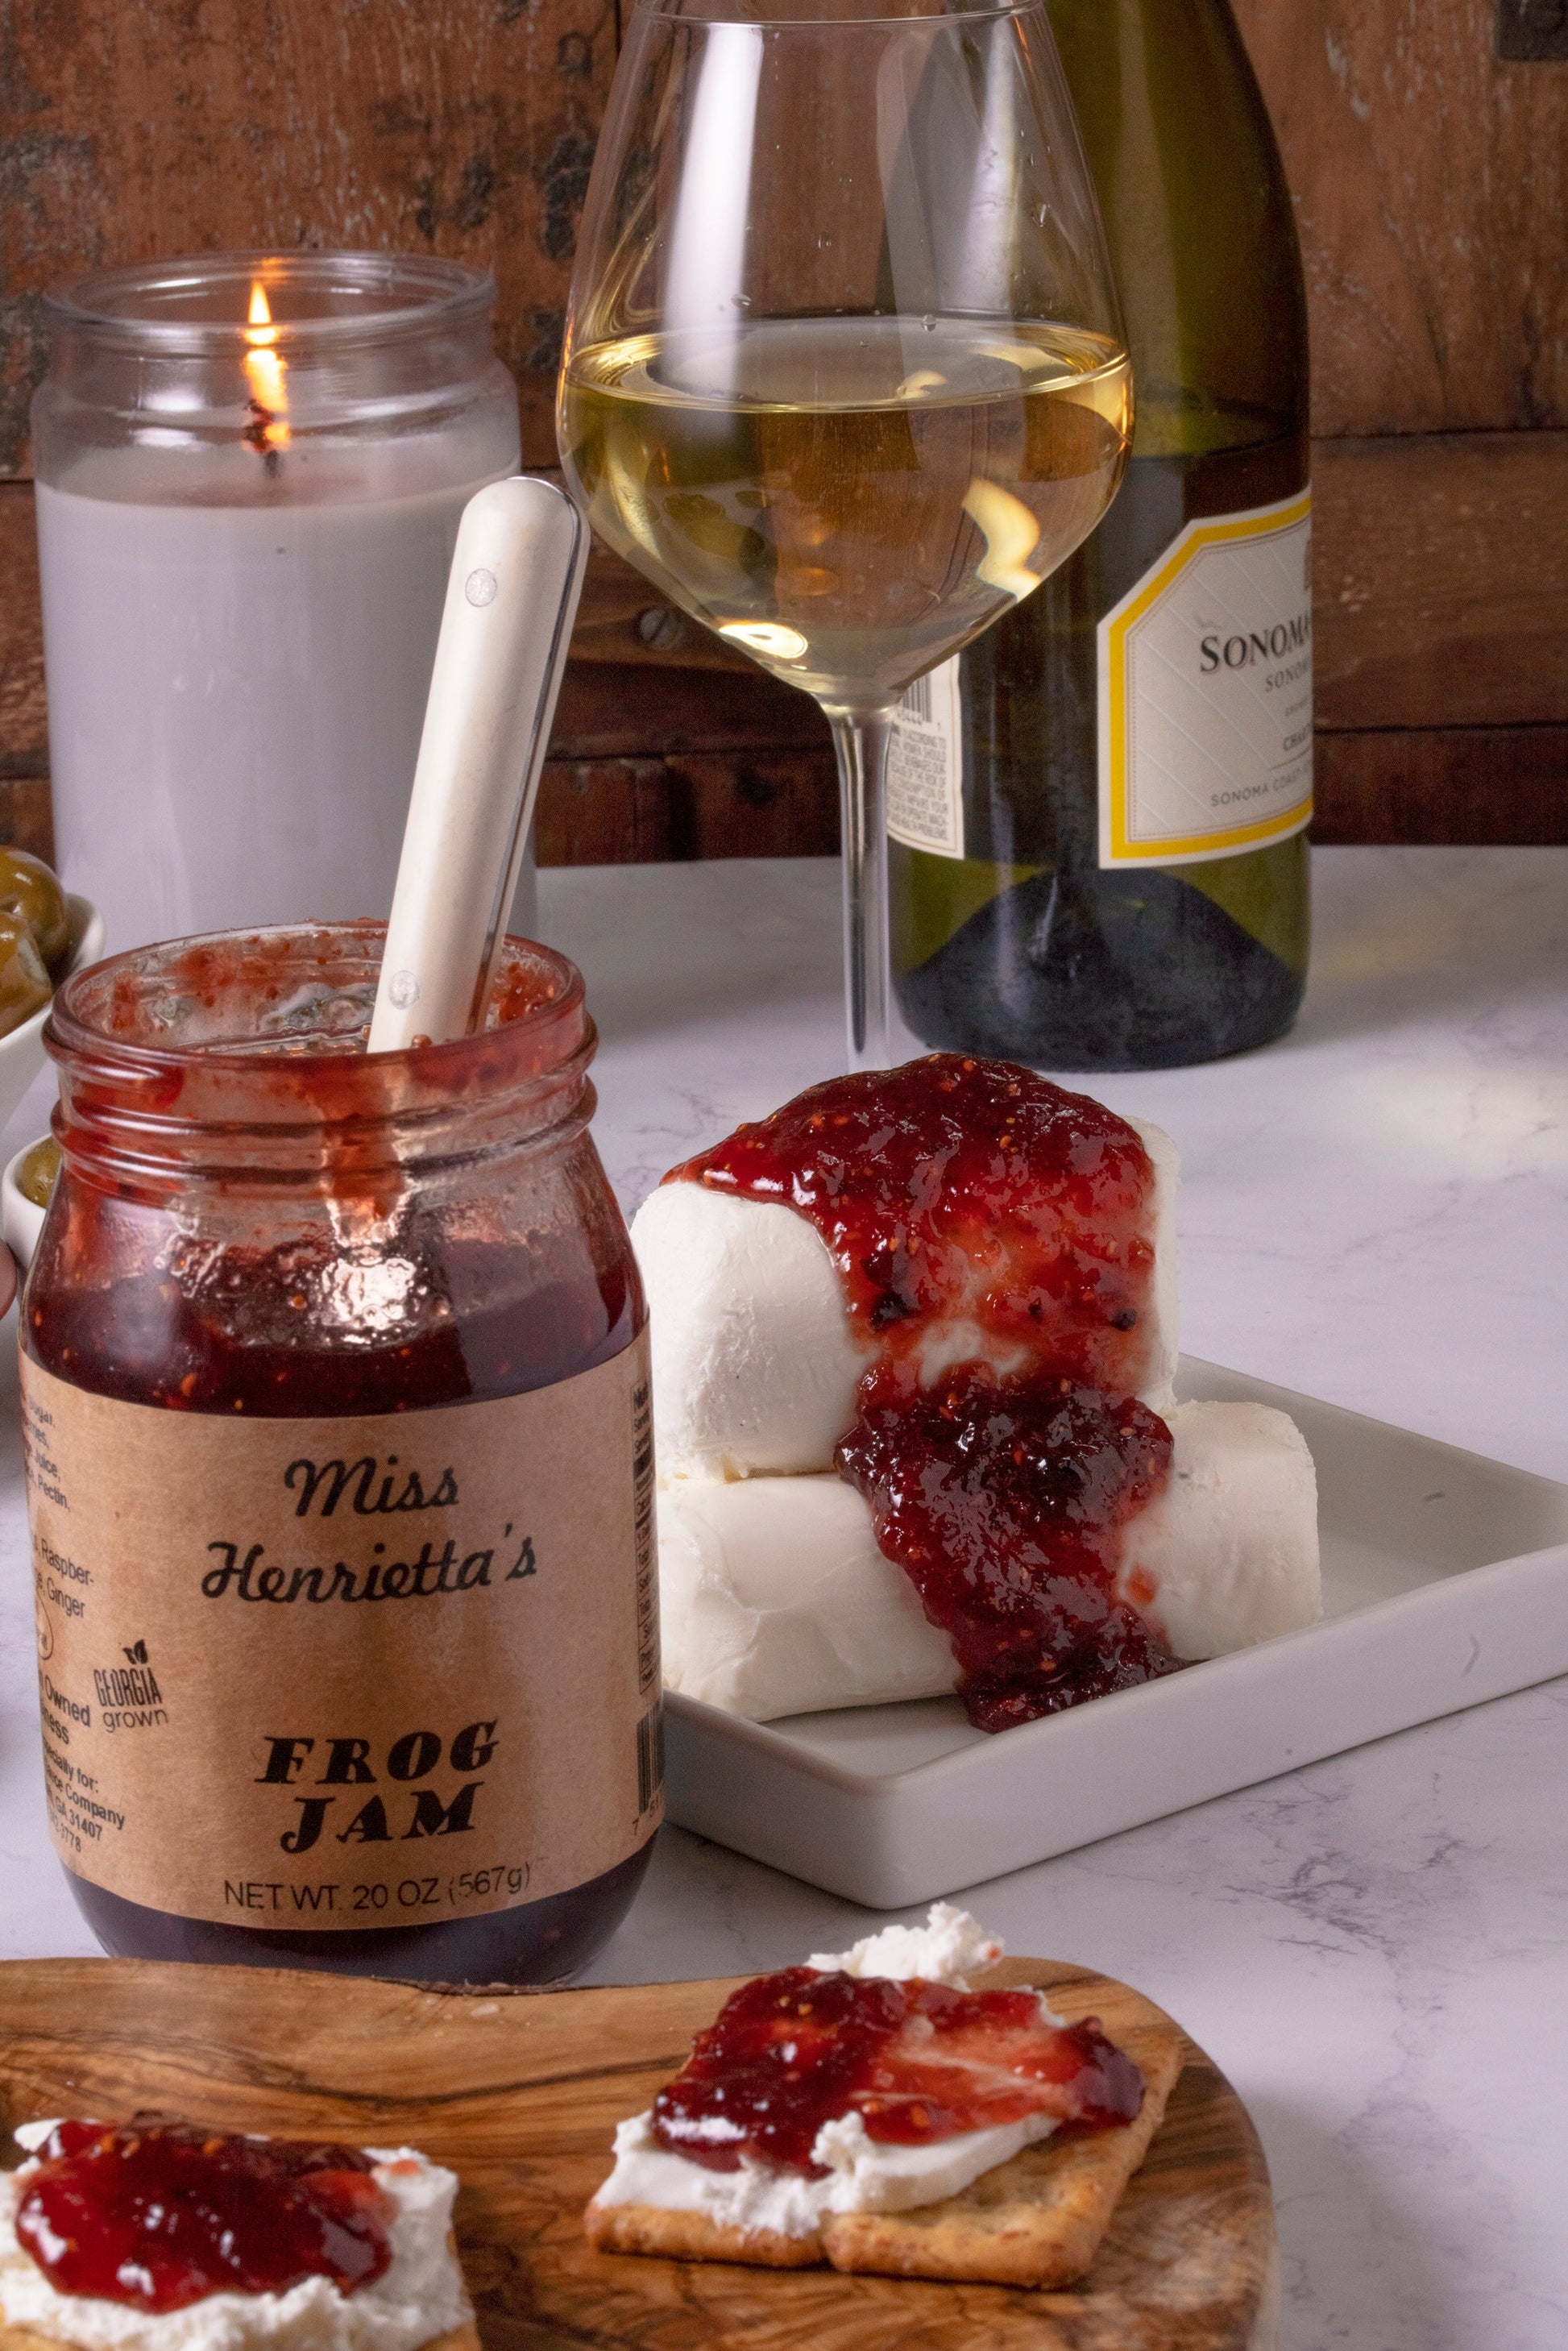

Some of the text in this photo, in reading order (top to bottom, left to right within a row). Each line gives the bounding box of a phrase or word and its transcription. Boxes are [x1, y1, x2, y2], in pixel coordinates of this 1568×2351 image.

[1211, 783, 1269, 807] SONOMA
[284, 1454, 459, 1517] Miss
[41, 1538, 94, 1586] Raspber-
[201, 1522, 537, 1603] Henrietta's
[47, 1576, 85, 1618] Ginger
[45, 1675, 90, 1727] Owned
[93, 1667, 162, 1707] GEORGIA
[102, 1708, 168, 1733] grown
[254, 1718, 500, 1785] FROG
[77, 1767, 98, 1793] for:
[65, 1783, 125, 1831] Company
[69, 1809, 102, 1842] 31407
[280, 1781, 485, 1854] JAM
[224, 1861, 530, 1911] NET WT. 20 OZ (567g)
